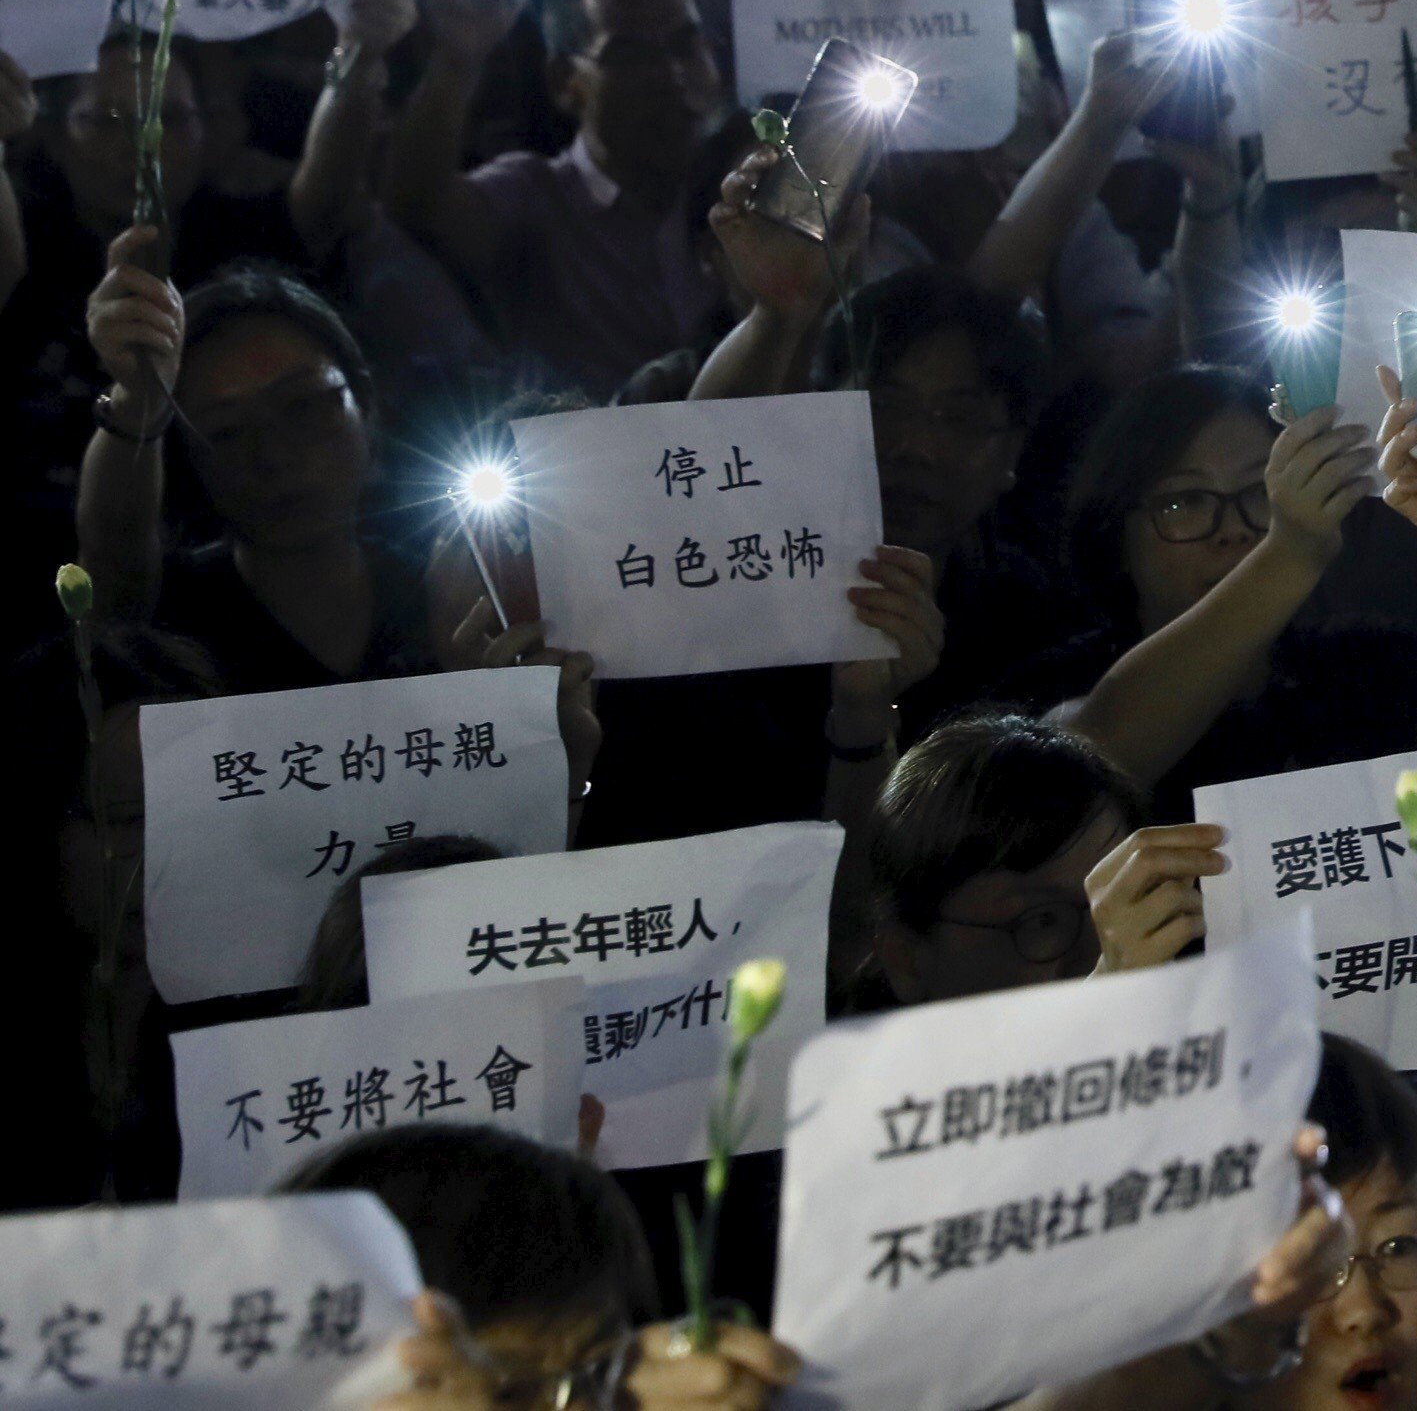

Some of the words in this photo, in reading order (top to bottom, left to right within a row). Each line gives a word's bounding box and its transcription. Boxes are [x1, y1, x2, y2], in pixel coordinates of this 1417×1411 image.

[909, 7, 978, 41] WILL
[653, 442, 764, 499] 停止
[613, 527, 827, 590] 白色恐怖
[212, 719, 509, 802] 堅定的母親
[224, 1043, 533, 1152] 不要將社會
[866, 1140, 1264, 1294] 不要與社會為敵
[0, 1280, 371, 1390] 定的母親
